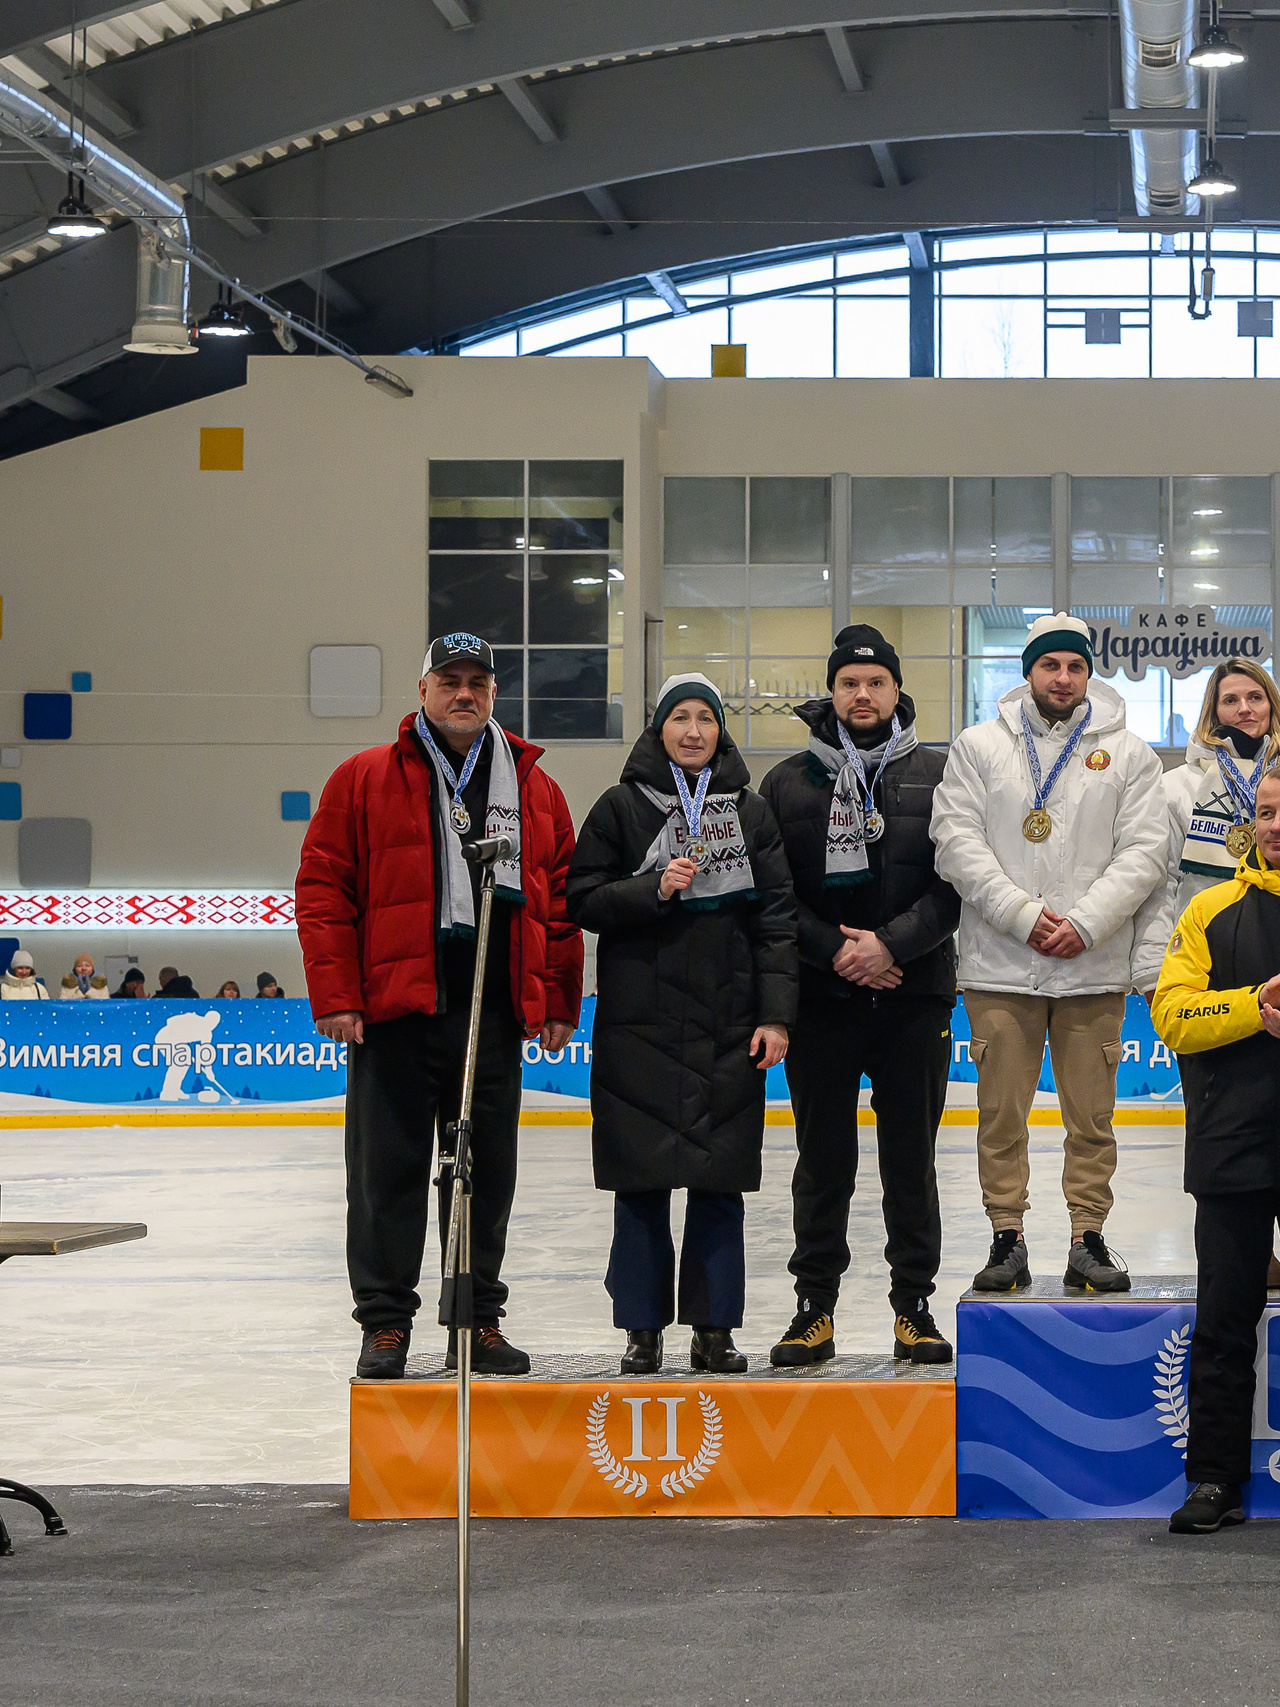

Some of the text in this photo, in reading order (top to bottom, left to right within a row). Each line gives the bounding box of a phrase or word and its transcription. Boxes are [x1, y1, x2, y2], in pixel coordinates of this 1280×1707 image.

[1139, 613, 1207, 628] КАФЕ
[674, 821, 736, 844] ЕИНЫЕ
[1190, 818, 1227, 836] БЕЛЫЕ
[132, 1042, 347, 1075] спартакиада
[622, 1397, 686, 1461] II
